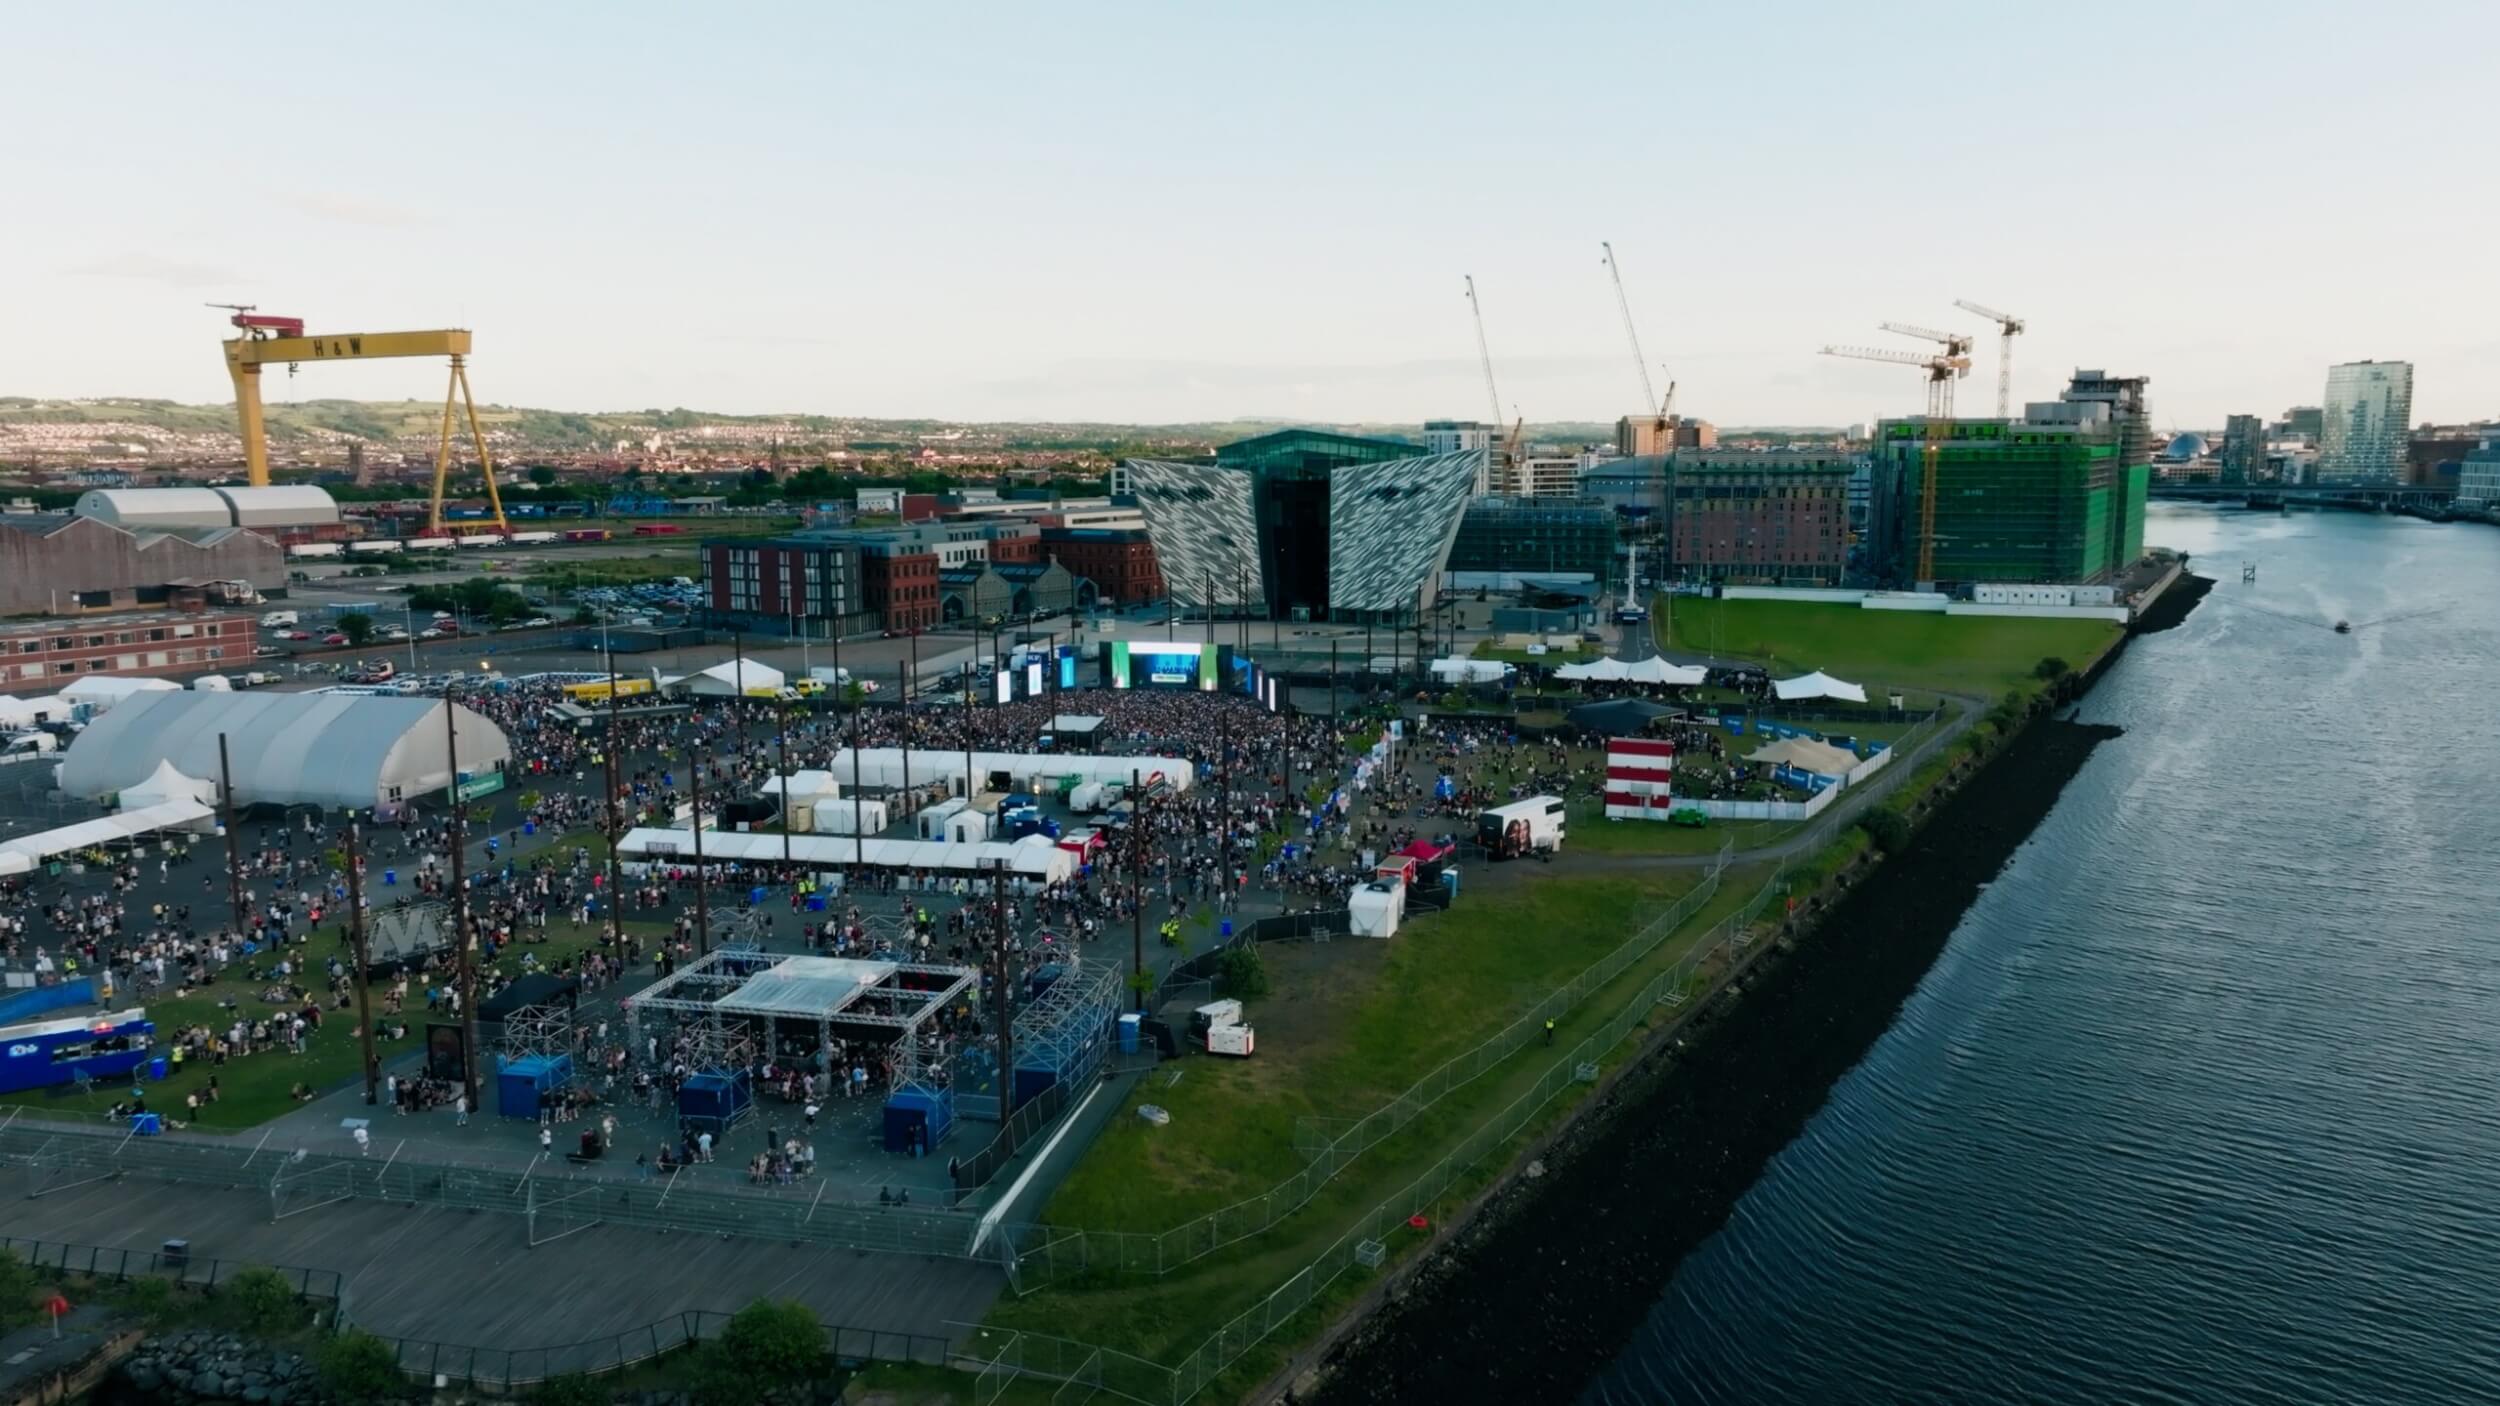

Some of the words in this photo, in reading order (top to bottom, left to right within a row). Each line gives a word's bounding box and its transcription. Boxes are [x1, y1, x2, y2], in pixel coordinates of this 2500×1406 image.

[313, 339, 324, 357] H
[333, 341, 342, 356] &
[349, 337, 361, 355] W
